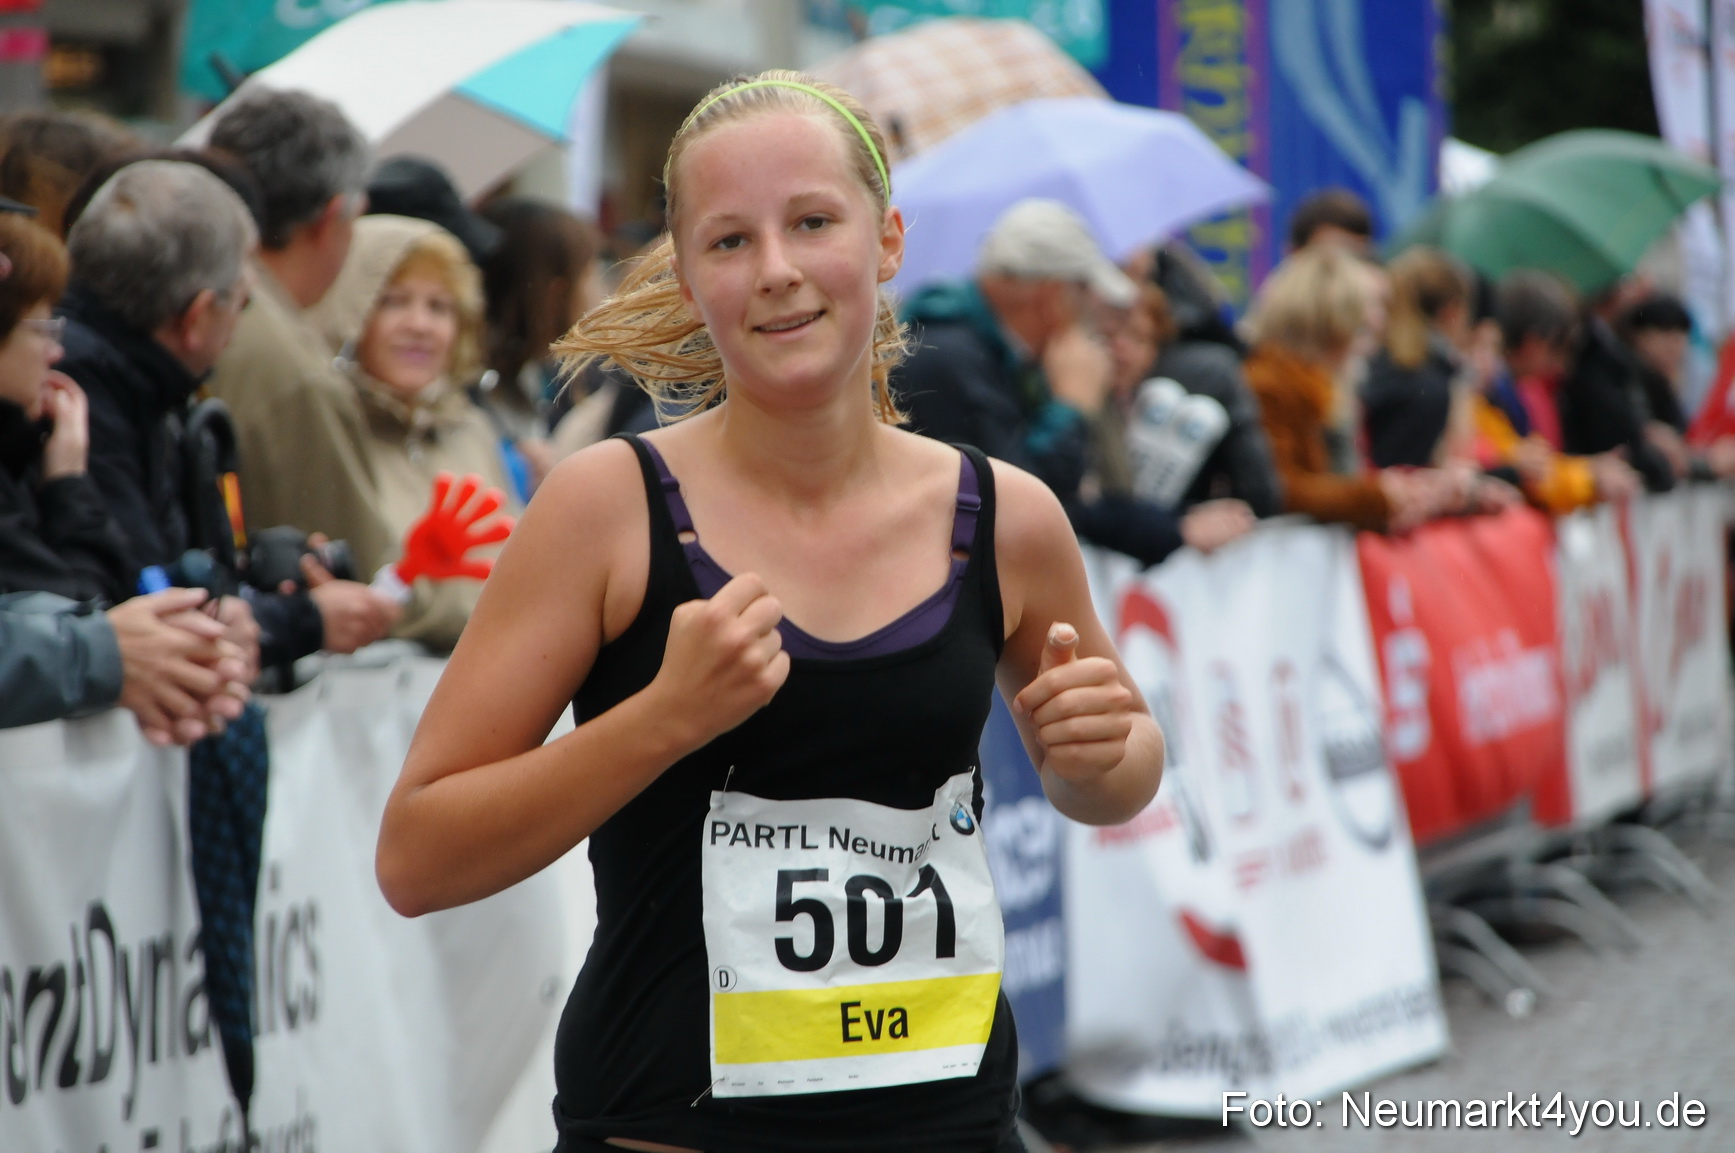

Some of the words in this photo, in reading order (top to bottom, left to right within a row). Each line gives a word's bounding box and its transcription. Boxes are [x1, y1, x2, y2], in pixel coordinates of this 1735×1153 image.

[710, 821, 818, 849] PARTL
[774, 863, 956, 972] 501
[0, 862, 319, 1121] entDynaics
[840, 1001, 909, 1043] Eva
